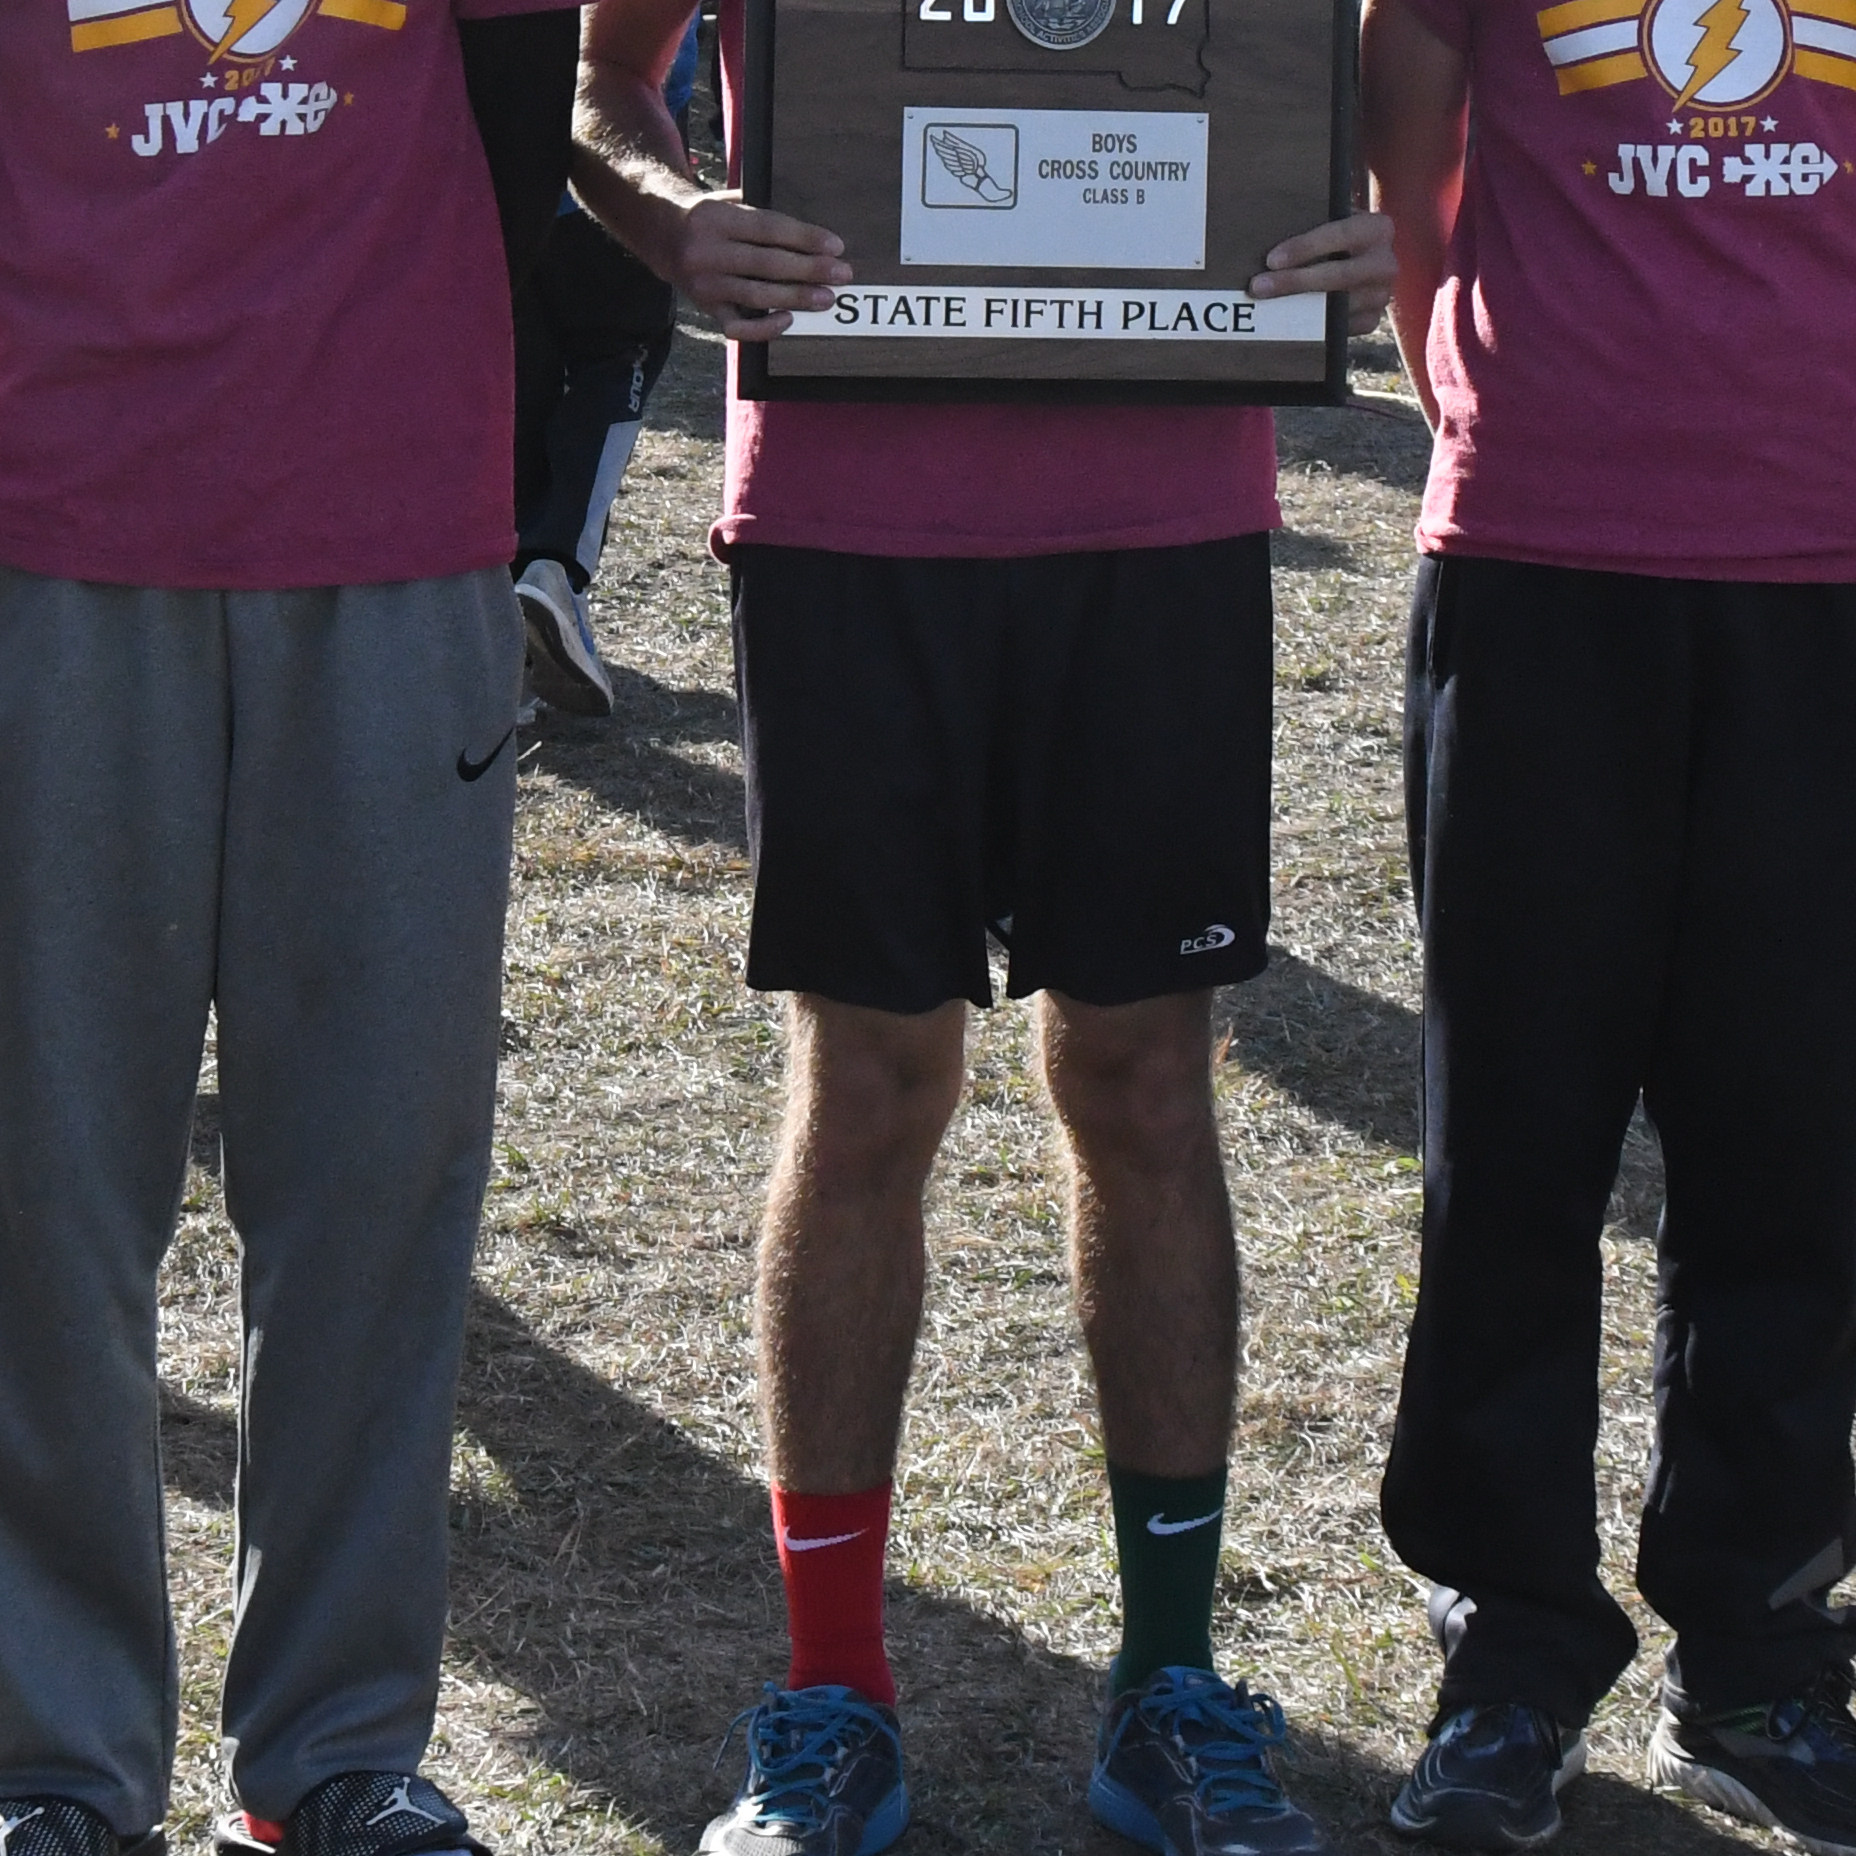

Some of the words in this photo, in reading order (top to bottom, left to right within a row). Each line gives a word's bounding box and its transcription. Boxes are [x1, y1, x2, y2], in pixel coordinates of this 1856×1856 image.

[131, 97, 235, 156] JVC
[1689, 116, 1756, 138] 2017
[1092, 133, 1138, 154] BOYS
[1037, 159, 1099, 180] CROSS
[1109, 160, 1191, 182] COUNTRY
[1607, 144, 1711, 198] JVC
[1744, 143, 1821, 197] XC
[1082, 188, 1129, 204] CLASS
[1136, 189, 1146, 205] B
[834, 293, 968, 327] STATE
[983, 297, 1104, 330] FIFTH
[1121, 301, 1256, 333] PLACE
